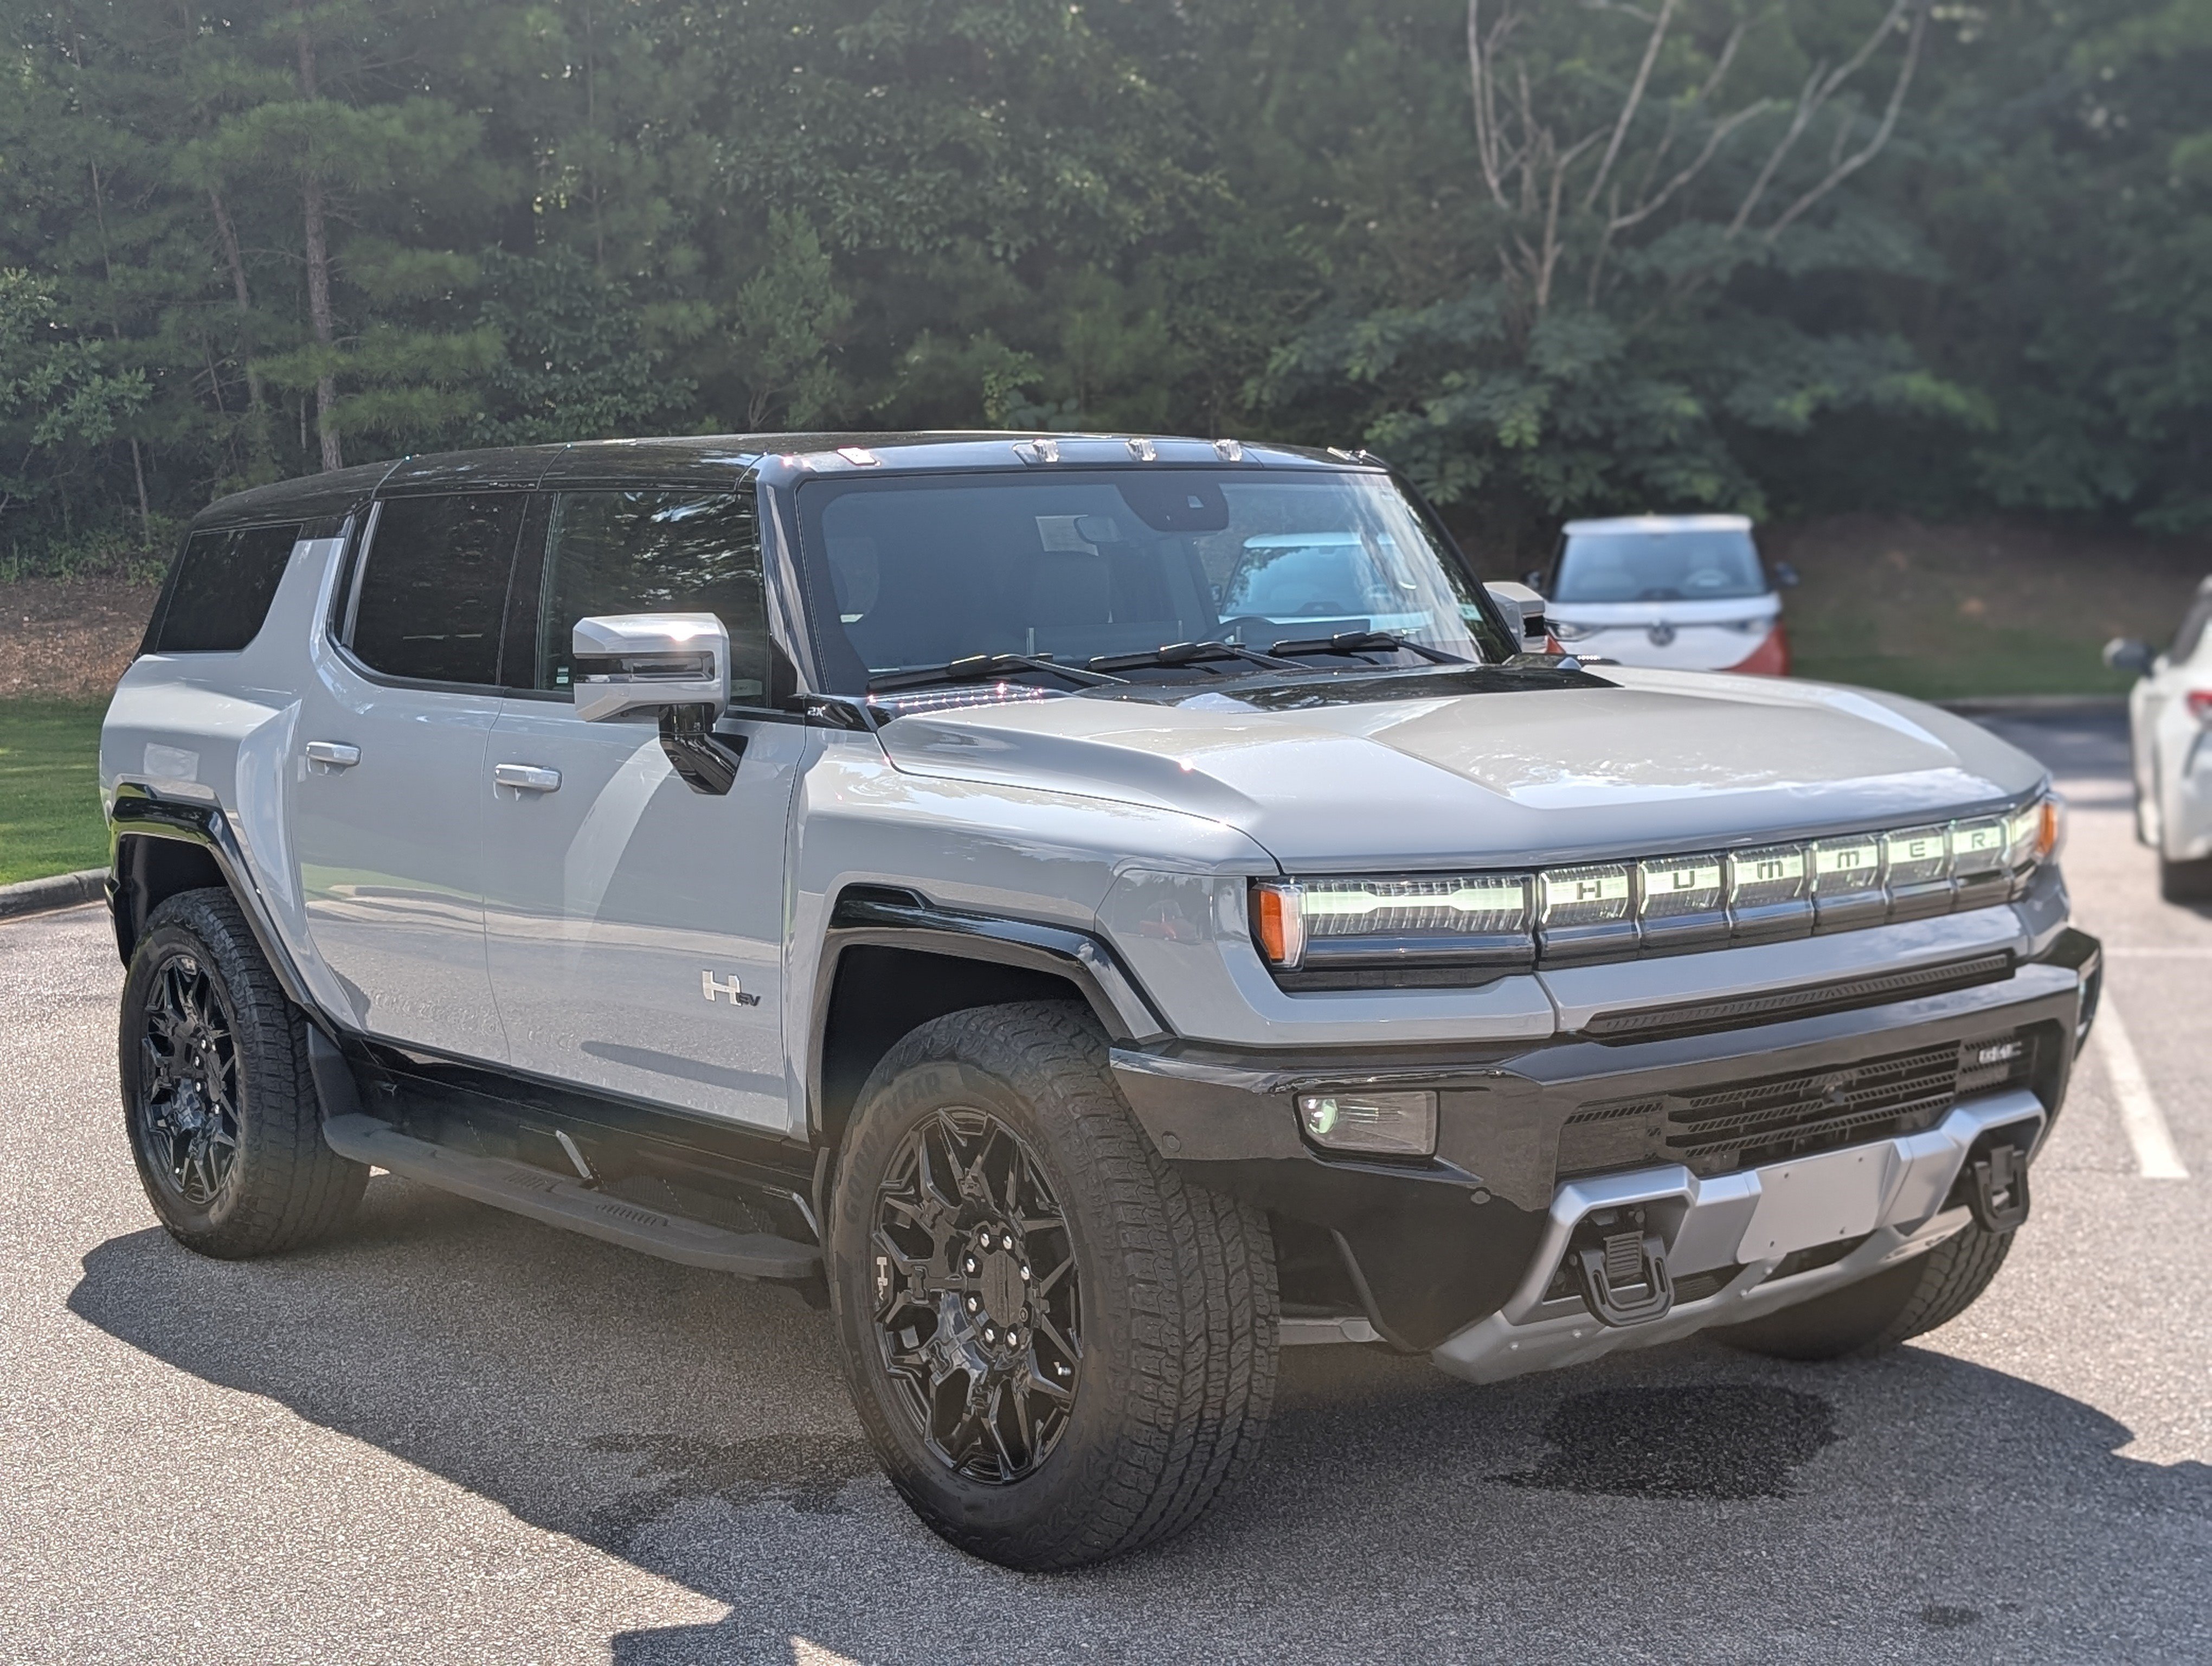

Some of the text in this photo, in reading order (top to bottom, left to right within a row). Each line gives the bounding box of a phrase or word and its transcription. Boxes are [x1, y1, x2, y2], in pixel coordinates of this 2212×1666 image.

[807, 706, 826, 717] 2X
[1576, 833, 1985, 900] HUMMER
[844, 1071, 942, 1225] GOODYEAR
